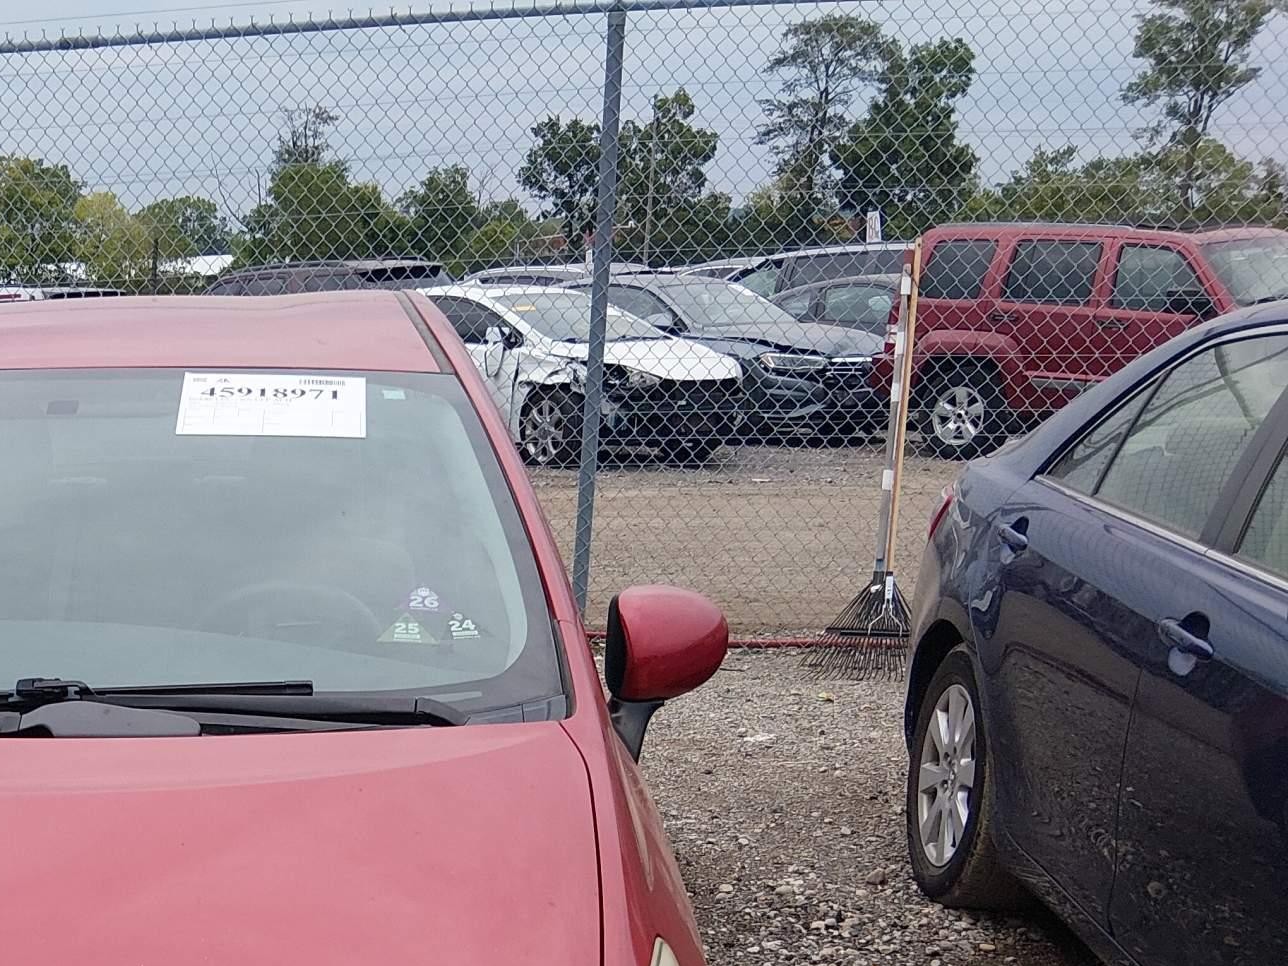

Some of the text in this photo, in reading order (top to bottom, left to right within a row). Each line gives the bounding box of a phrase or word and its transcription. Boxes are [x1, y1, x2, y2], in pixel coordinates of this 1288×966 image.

[201, 386, 338, 400] 45918971
[409, 595, 439, 608] 26
[394, 622, 420, 634] 25
[448, 619, 476, 631] 24
